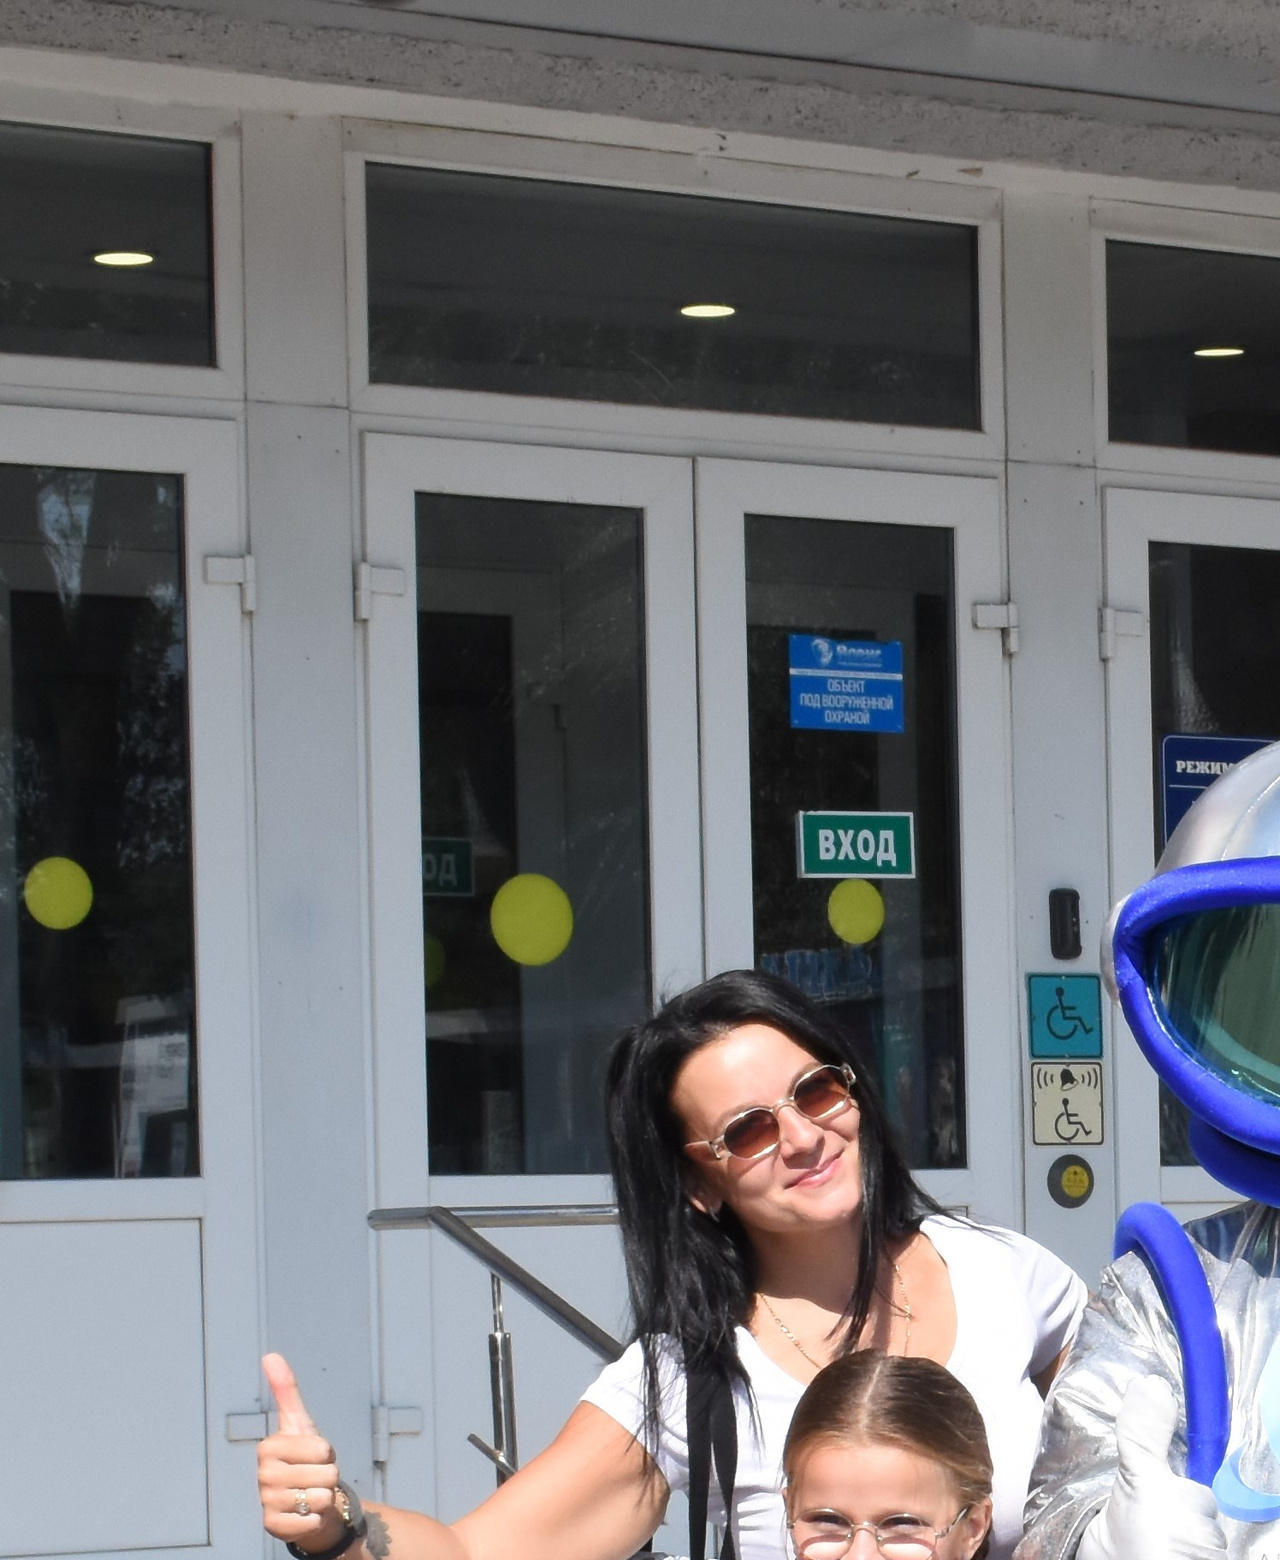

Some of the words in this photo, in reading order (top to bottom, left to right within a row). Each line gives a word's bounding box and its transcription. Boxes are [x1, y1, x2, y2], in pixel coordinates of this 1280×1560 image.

[827, 679, 866, 693] ОБЪЕКТ
[800, 693, 821, 709] ПОД
[822, 694, 894, 711] ВООРУЖЕННОЙ
[824, 710, 870, 725] ОХРАНОЙ
[818, 829, 897, 867] ВХОД
